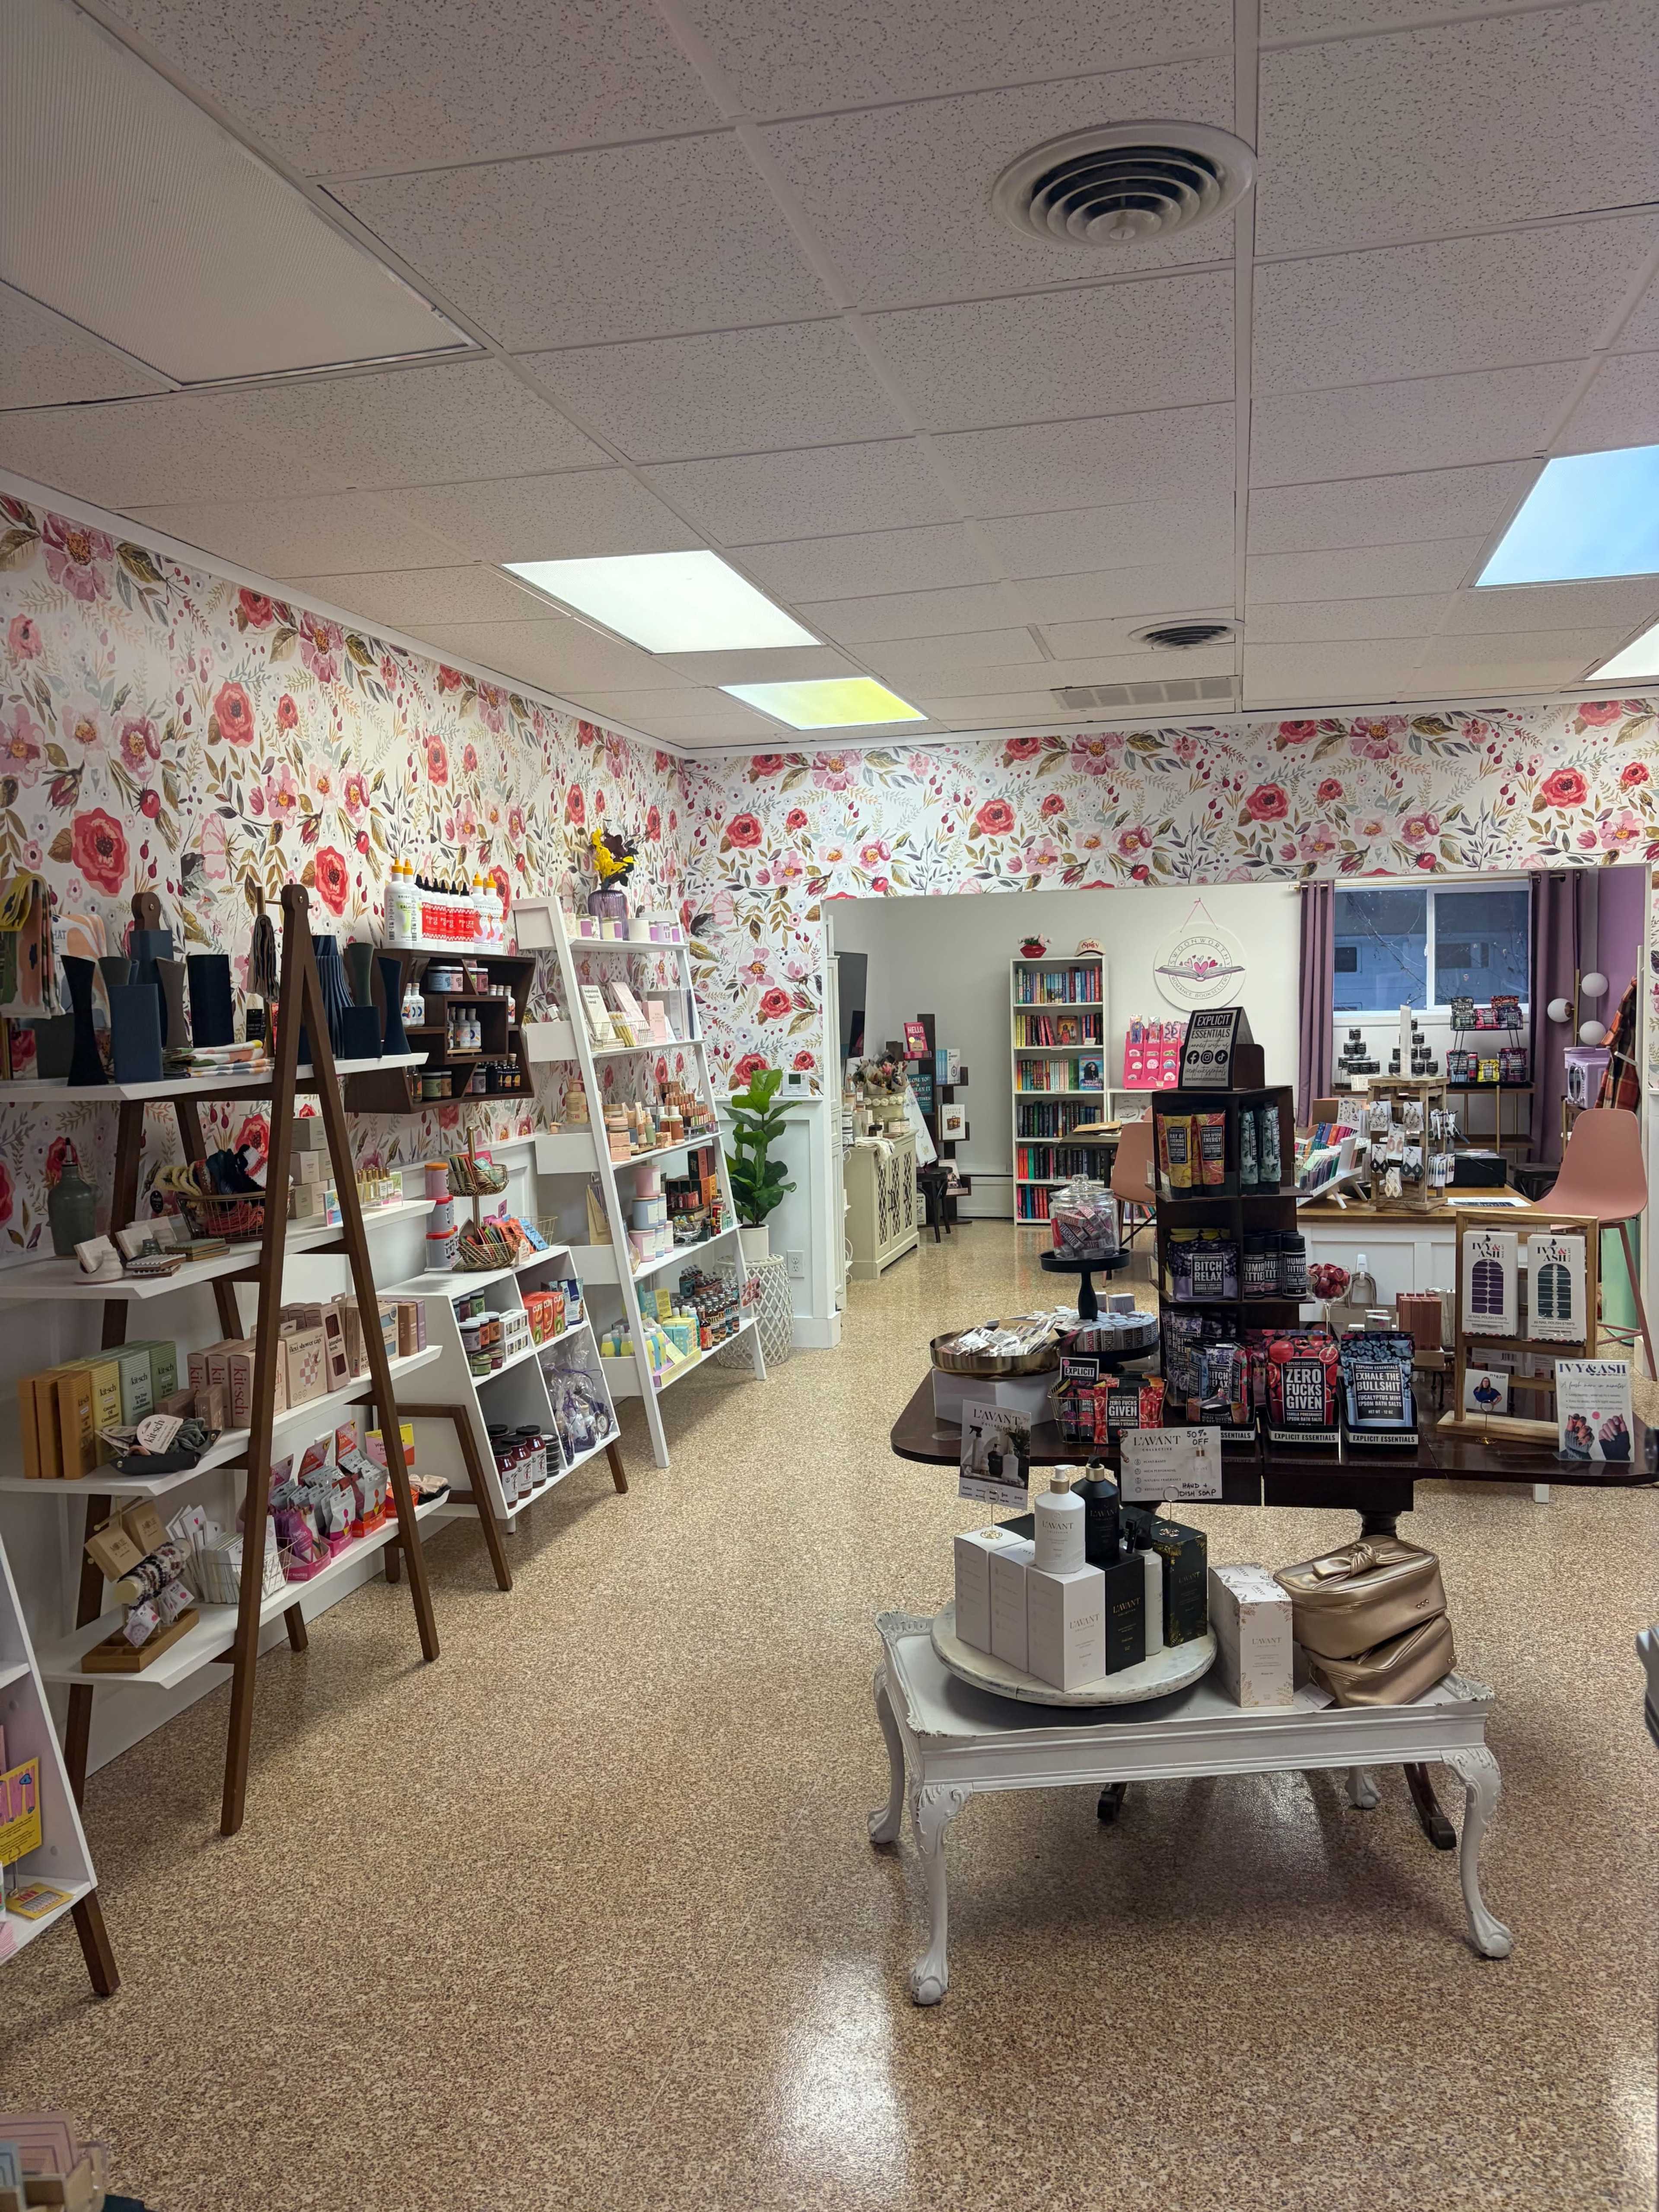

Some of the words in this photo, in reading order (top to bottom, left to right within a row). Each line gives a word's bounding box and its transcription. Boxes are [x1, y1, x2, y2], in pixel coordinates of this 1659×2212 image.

[53, 930, 66, 939] HAT
[1082, 941, 1099, 949] Spicy
[1170, 938, 1231, 965] SWOONWORTHY
[1171, 976, 1192, 996] ROMANCE
[1197, 1015, 1230, 1026] EXPLICIT
[1192, 1029, 1230, 1038] ESSENTIALS
[1195, 1261, 1222, 1271] BITCH
[1195, 1272, 1223, 1281] RELAX
[554, 1294, 564, 1302] cure
[533, 1304, 543, 1312] cure
[543, 1300, 553, 1308] cure
[299, 1341, 314, 1349] shower
[1105, 1331, 1114, 1351] BITCHS
[1065, 1367, 1094, 1376] EXPLICIT
[1286, 1369, 1322, 1383] ZERO
[1356, 1372, 1384, 1381] EXHALE
[1386, 1373, 1400, 1381] THE
[1286, 1384, 1322, 1396] FUCKS
[1357, 1381, 1401, 1392] BULLSHIT
[1287, 1396, 1322, 1410] GIVEN
[1109, 1406, 1138, 1416] GIVEN
[1187, 1429, 1207, 1438] 50%
[1134, 1435, 1181, 1446] L'AVANT
[1042, 1521, 1074, 1530] L'AVANT
[1113, 1598, 1141, 1614] L'AVANT
[1070, 1613, 1100, 1629] L'AVANT
